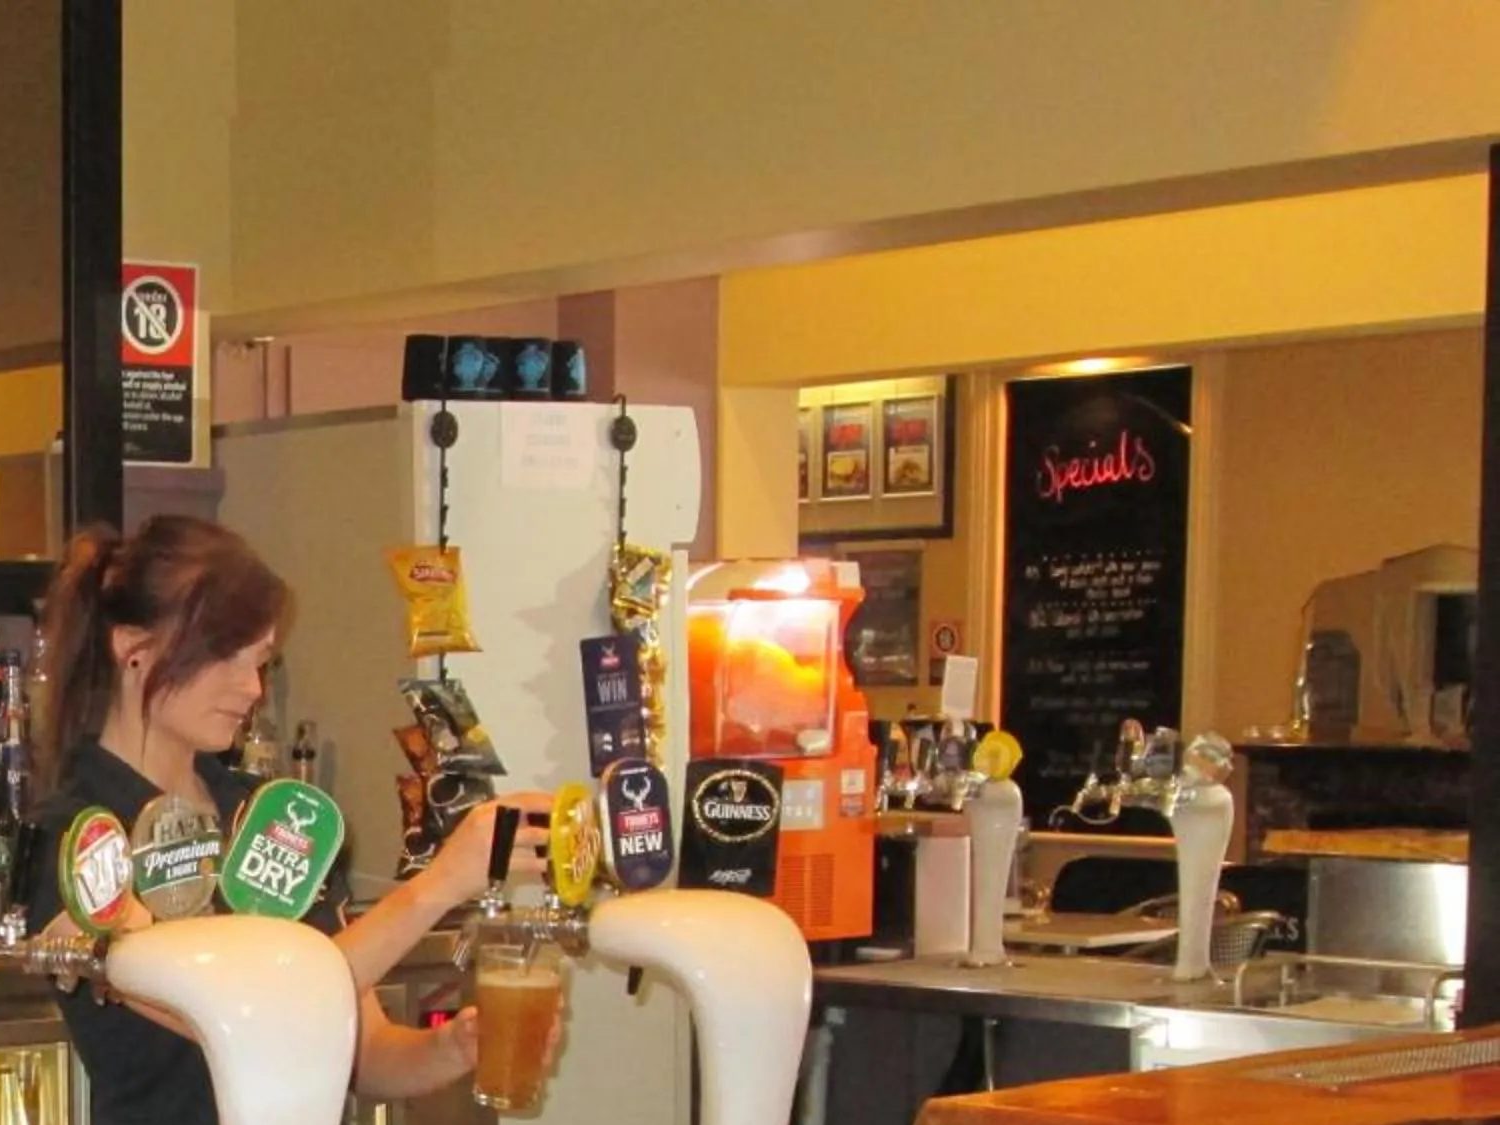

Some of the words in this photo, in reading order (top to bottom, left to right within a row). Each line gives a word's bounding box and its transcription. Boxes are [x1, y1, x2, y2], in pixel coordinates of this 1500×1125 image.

[133, 303, 167, 339] 18
[1037, 430, 1155, 503] Specials
[597, 679, 627, 704] WIN
[703, 801, 771, 821] GUINNESS
[144, 839, 220, 877] Premium
[250, 833, 310, 877] EXTRA
[619, 831, 663, 857] NEW
[238, 849, 307, 896] DRY
